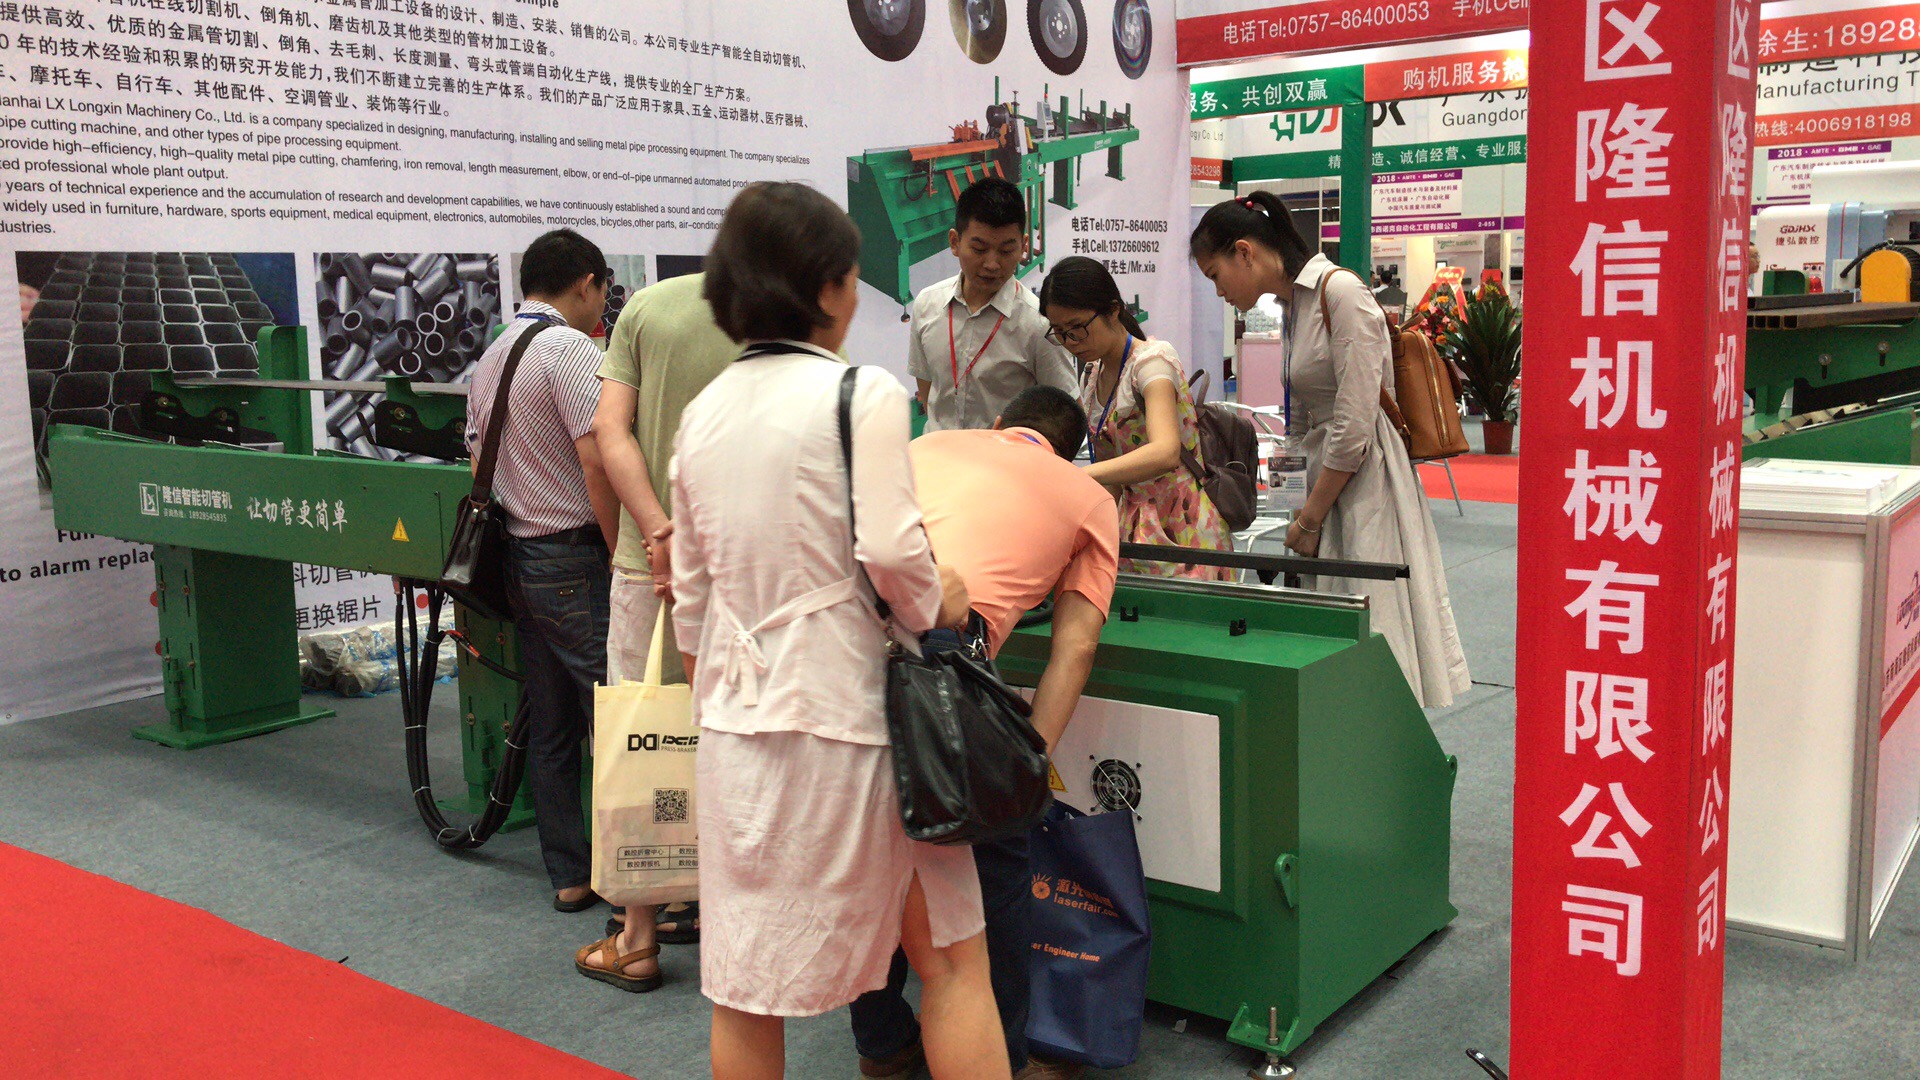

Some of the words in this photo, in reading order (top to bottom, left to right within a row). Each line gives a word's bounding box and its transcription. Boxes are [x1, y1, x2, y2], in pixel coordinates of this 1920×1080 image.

[1223, 1, 1430, 45] 电话Tel:0757-86400053
[1758, 18, 1920, 56] 余生:18928
[31, 119, 76, 134] cutting
[81, 122, 141, 137] machine,
[145, 126, 168, 137] and
[173, 128, 204, 140] other
[207, 130, 239, 144] types
[243, 132, 253, 142] of
[258, 133, 281, 146] pipe
[285, 135, 342, 150] processing
[346, 140, 402, 151] equipment.
[46, 97, 65, 110] LX
[70, 99, 121, 116] Longxin
[127, 103, 191, 122] Machinery
[196, 109, 220, 123] Co.,
[224, 111, 246, 124] Ltd.
[250, 113, 258, 124] is
[263, 117, 269, 125] a
[273, 117, 322, 131] company
[326, 119, 383, 132] specialized
[387, 123, 395, 133] in
[398, 124, 447, 138] designing,
[451, 128, 517, 143] manufacturing,
[520, 133, 557, 147] installing
[560, 136, 575, 146] and
[578, 138, 603, 150] selling
[606, 141, 627, 150] metal
[630, 142, 646, 154] pipe
[648, 145, 688, 156] processing
[730, 150, 743, 159] The
[745, 153, 774, 164] company
[776, 154, 810, 165] specializes
[1371, 140, 1527, 167] 造、诚信经营、专业服
[1778, 149, 1802, 158] 2018
[25, 159, 107, 173] professional
[112, 164, 149, 176] whole
[154, 166, 183, 179] plant
[187, 167, 228, 181] output.
[238, 151, 268, 161] metal
[273, 153, 296, 165] pipe
[300, 154, 338, 167] cutting,
[341, 156, 401, 171] chamfering,
[404, 159, 422, 169] iron
[426, 161, 466, 173] removal,
[469, 162, 496, 175] length
[499, 166, 561, 178] measurement,
[564, 169, 590, 180] elbow,
[654, 175, 692, 185] unmanned
[694, 178, 731, 187] automated
[1377, 174, 1396, 183] 2018
[6, 181, 45, 193] years
[50, 181, 62, 192] of
[67, 182, 125, 195] technical
[130, 184, 198, 198] experience
[202, 187, 223, 198] and
[228, 187, 245, 198] the
[250, 188, 321, 201] accumulation
[326, 190, 335, 201] of
[339, 192, 383, 203] research
[386, 193, 404, 203] and
[407, 193, 468, 206] development
[471, 196, 522, 208] capabilities,
[525, 200, 537, 208] we
[541, 199, 560, 209] have
[563, 201, 613, 212] continuously
[616, 203, 658, 213] established
[668, 205, 689, 214] sound
[692, 205, 705, 215] and
[3, 200, 47, 215] widely
[53, 201, 85, 214] used
[90, 202, 101, 214] in
[106, 202, 163, 217] furniture,
[167, 204, 227, 218] hardware,
[231, 206, 265, 219] sports
[270, 208, 330, 221] equipment,
[334, 209, 373, 220] medical
[376, 211, 430, 222] equipment,
[434, 212, 486, 224] electronics,
[489, 214, 544, 225] automobiles,
[547, 216, 598, 227] motorcycles,
[656, 219, 677, 229] parts,
[1071, 216, 1168, 233] 电话Tel:0757-86400053
[1072, 238, 1160, 254] 手机Cell:13726609612
[1559, 0, 1673, 976] 区隆信机械有限公司
[1697, 0, 1751, 955] 区隆信机械有限公司
[162, 486, 232, 510] 隆信智能切管机
[247, 496, 348, 533] 让切管更简单
[0, 568, 21, 582] to
[30, 559, 90, 579] alarm
[1044, 943, 1079, 959] Engineer
